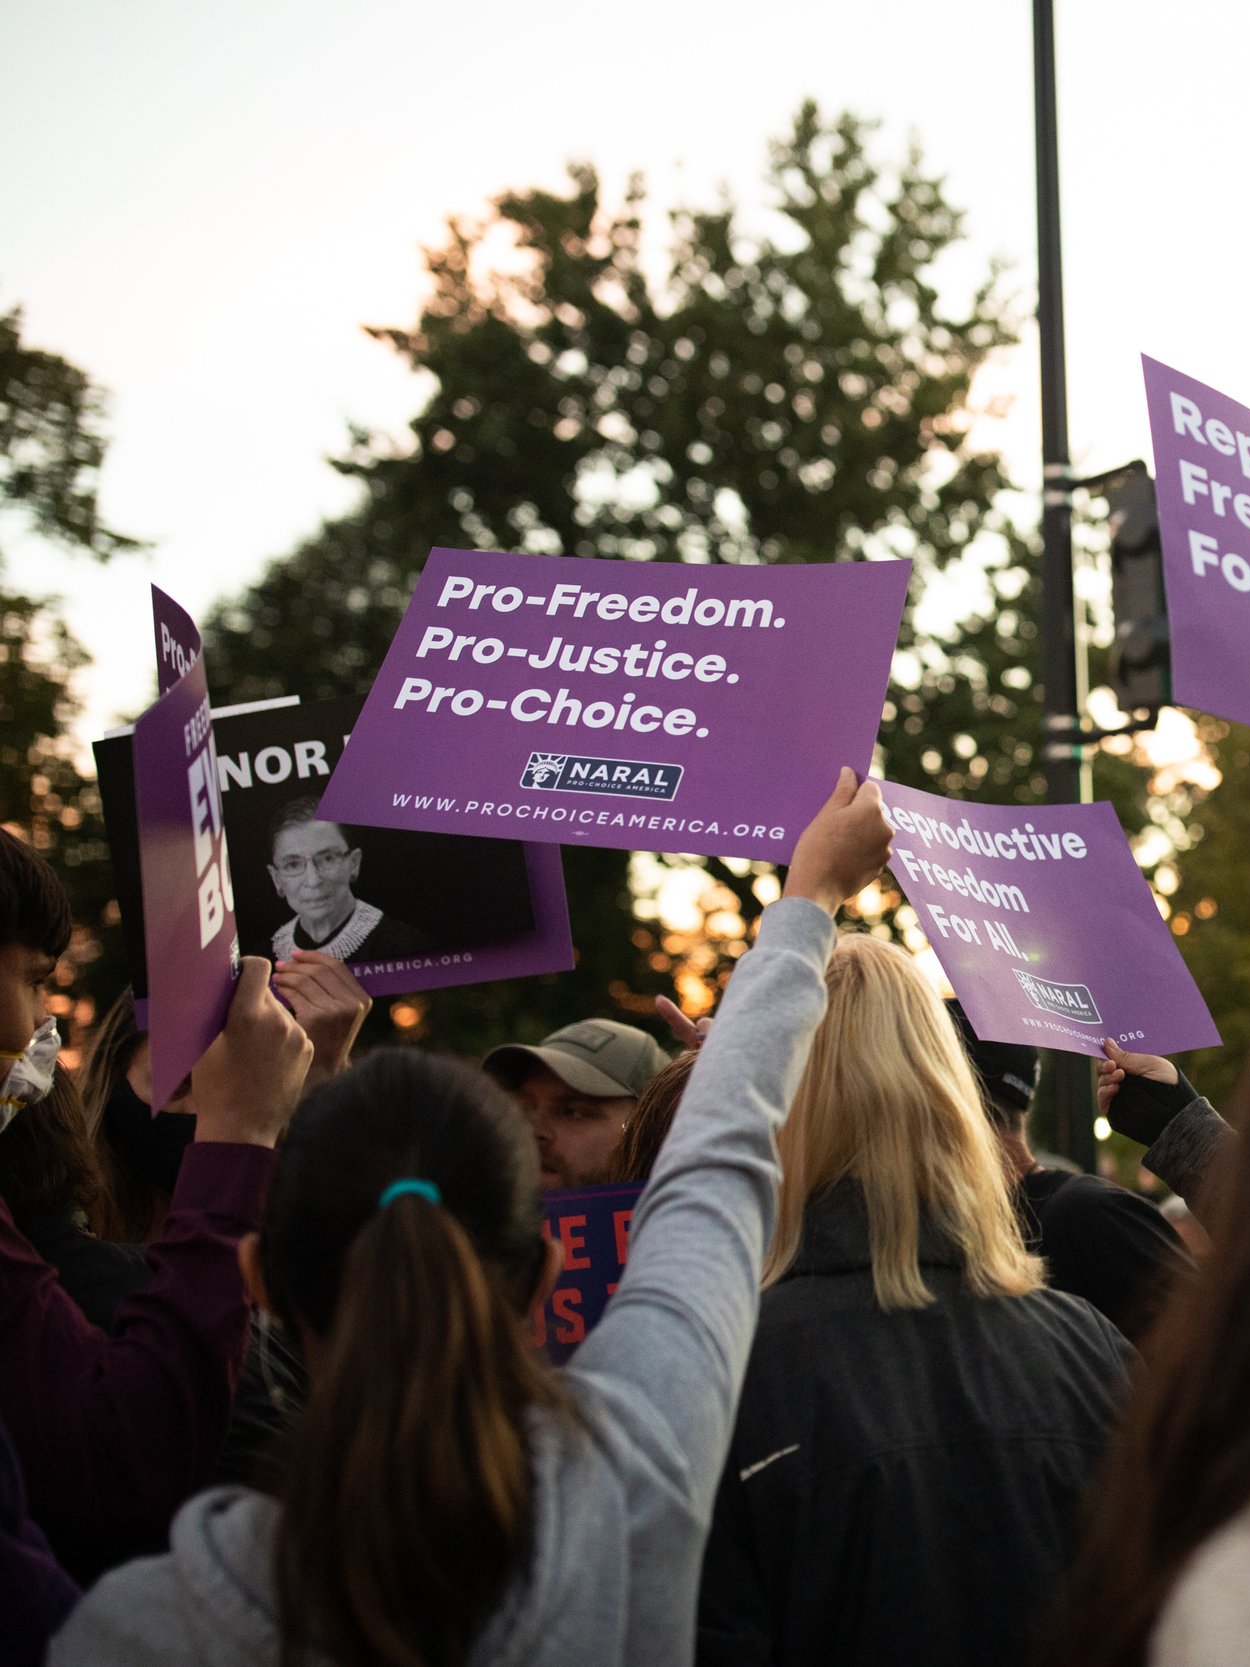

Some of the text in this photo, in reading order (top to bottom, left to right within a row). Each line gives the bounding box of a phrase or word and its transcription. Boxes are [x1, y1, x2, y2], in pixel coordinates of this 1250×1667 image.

[437, 576, 786, 629] Pro-Freedom.
[416, 626, 740, 684] Pro-Justice.
[393, 677, 710, 738] Pro-Choice.
[216, 740, 330, 793] NOR
[566, 779, 666, 793] PRO-CHOICE AMERICA
[569, 762, 669, 787] NARAL
[392, 793, 786, 841] WWW.PROCHOICEAMERICA.ORG
[896, 848, 1030, 913] Freedom
[927, 903, 1029, 961] For All.
[354, 952, 473, 978] EAMERICA.ORG
[1036, 982, 1089, 1008] NARAL
